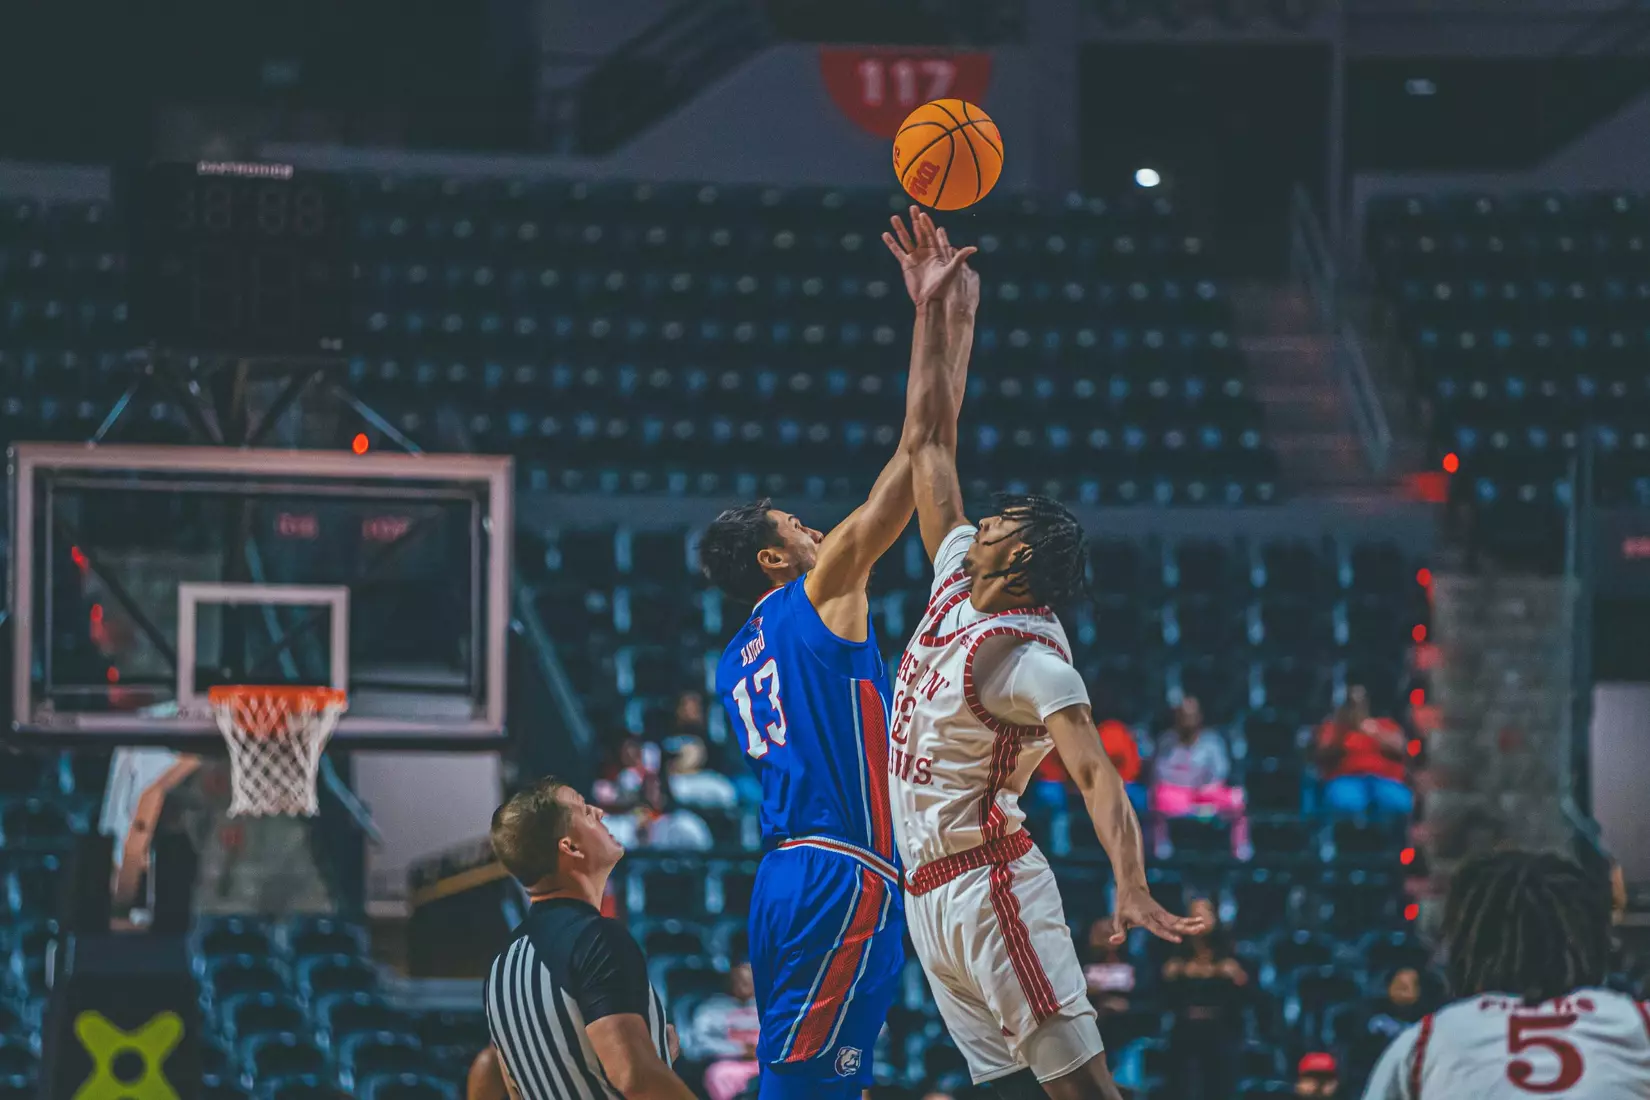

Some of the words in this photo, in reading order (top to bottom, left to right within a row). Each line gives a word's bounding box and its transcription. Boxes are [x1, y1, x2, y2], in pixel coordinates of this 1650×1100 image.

[857, 60, 958, 107] 117
[732, 657, 788, 760] 13
[1506, 1013, 1585, 1094] 5
